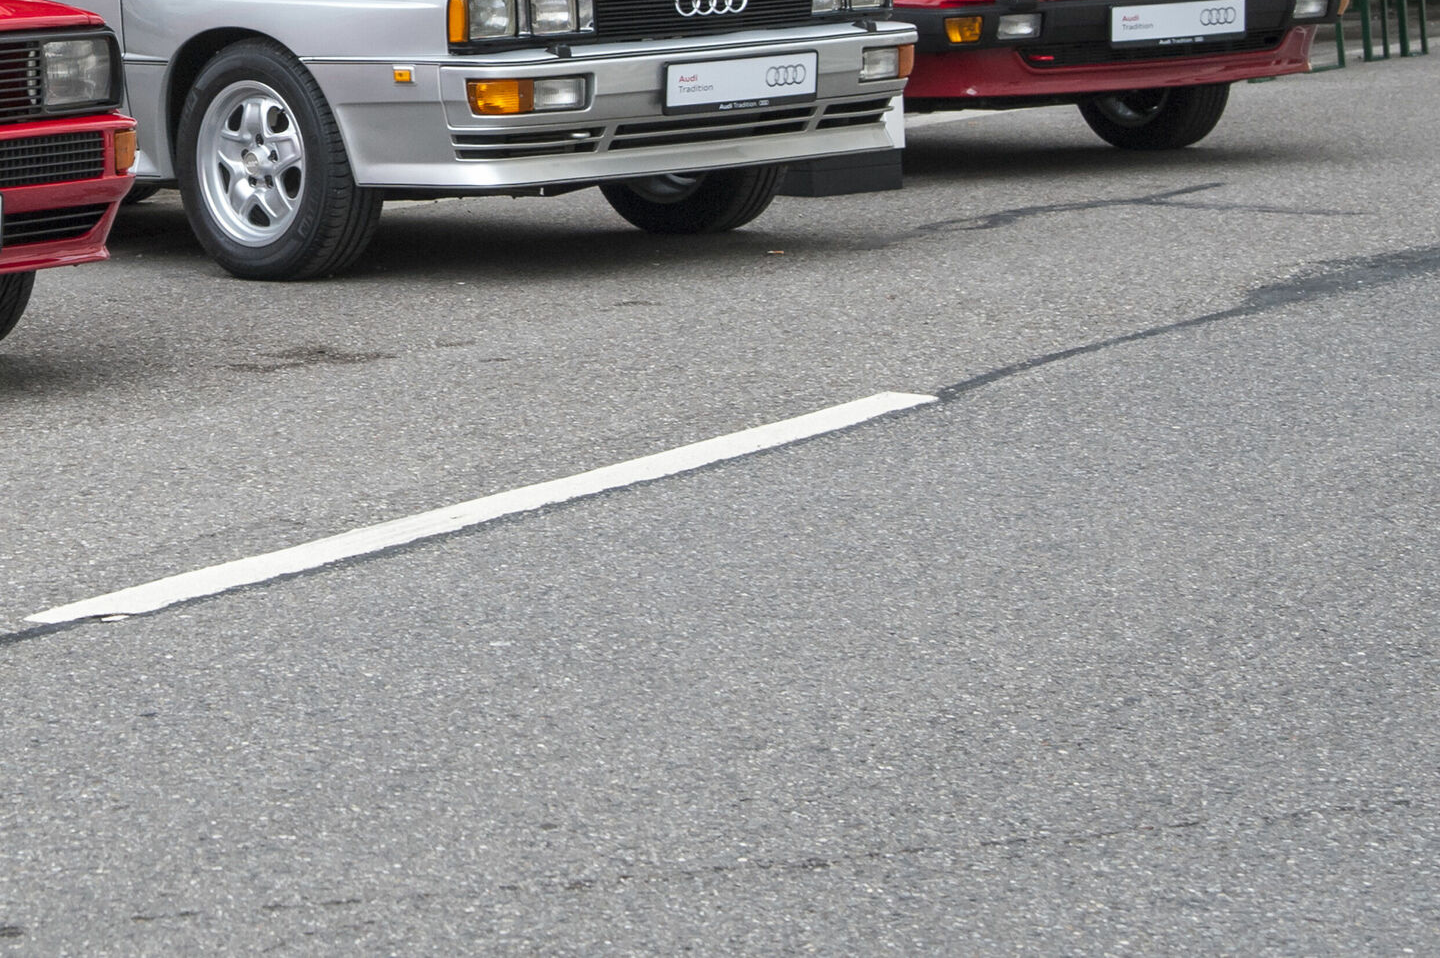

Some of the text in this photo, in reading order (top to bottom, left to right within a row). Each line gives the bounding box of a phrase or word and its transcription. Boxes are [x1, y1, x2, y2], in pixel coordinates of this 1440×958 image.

[1122, 22, 1153, 31] Tradition
[678, 75, 698, 83] Audi
[678, 83, 714, 93] Tradition
[719, 100, 757, 111] Audi Tradition
